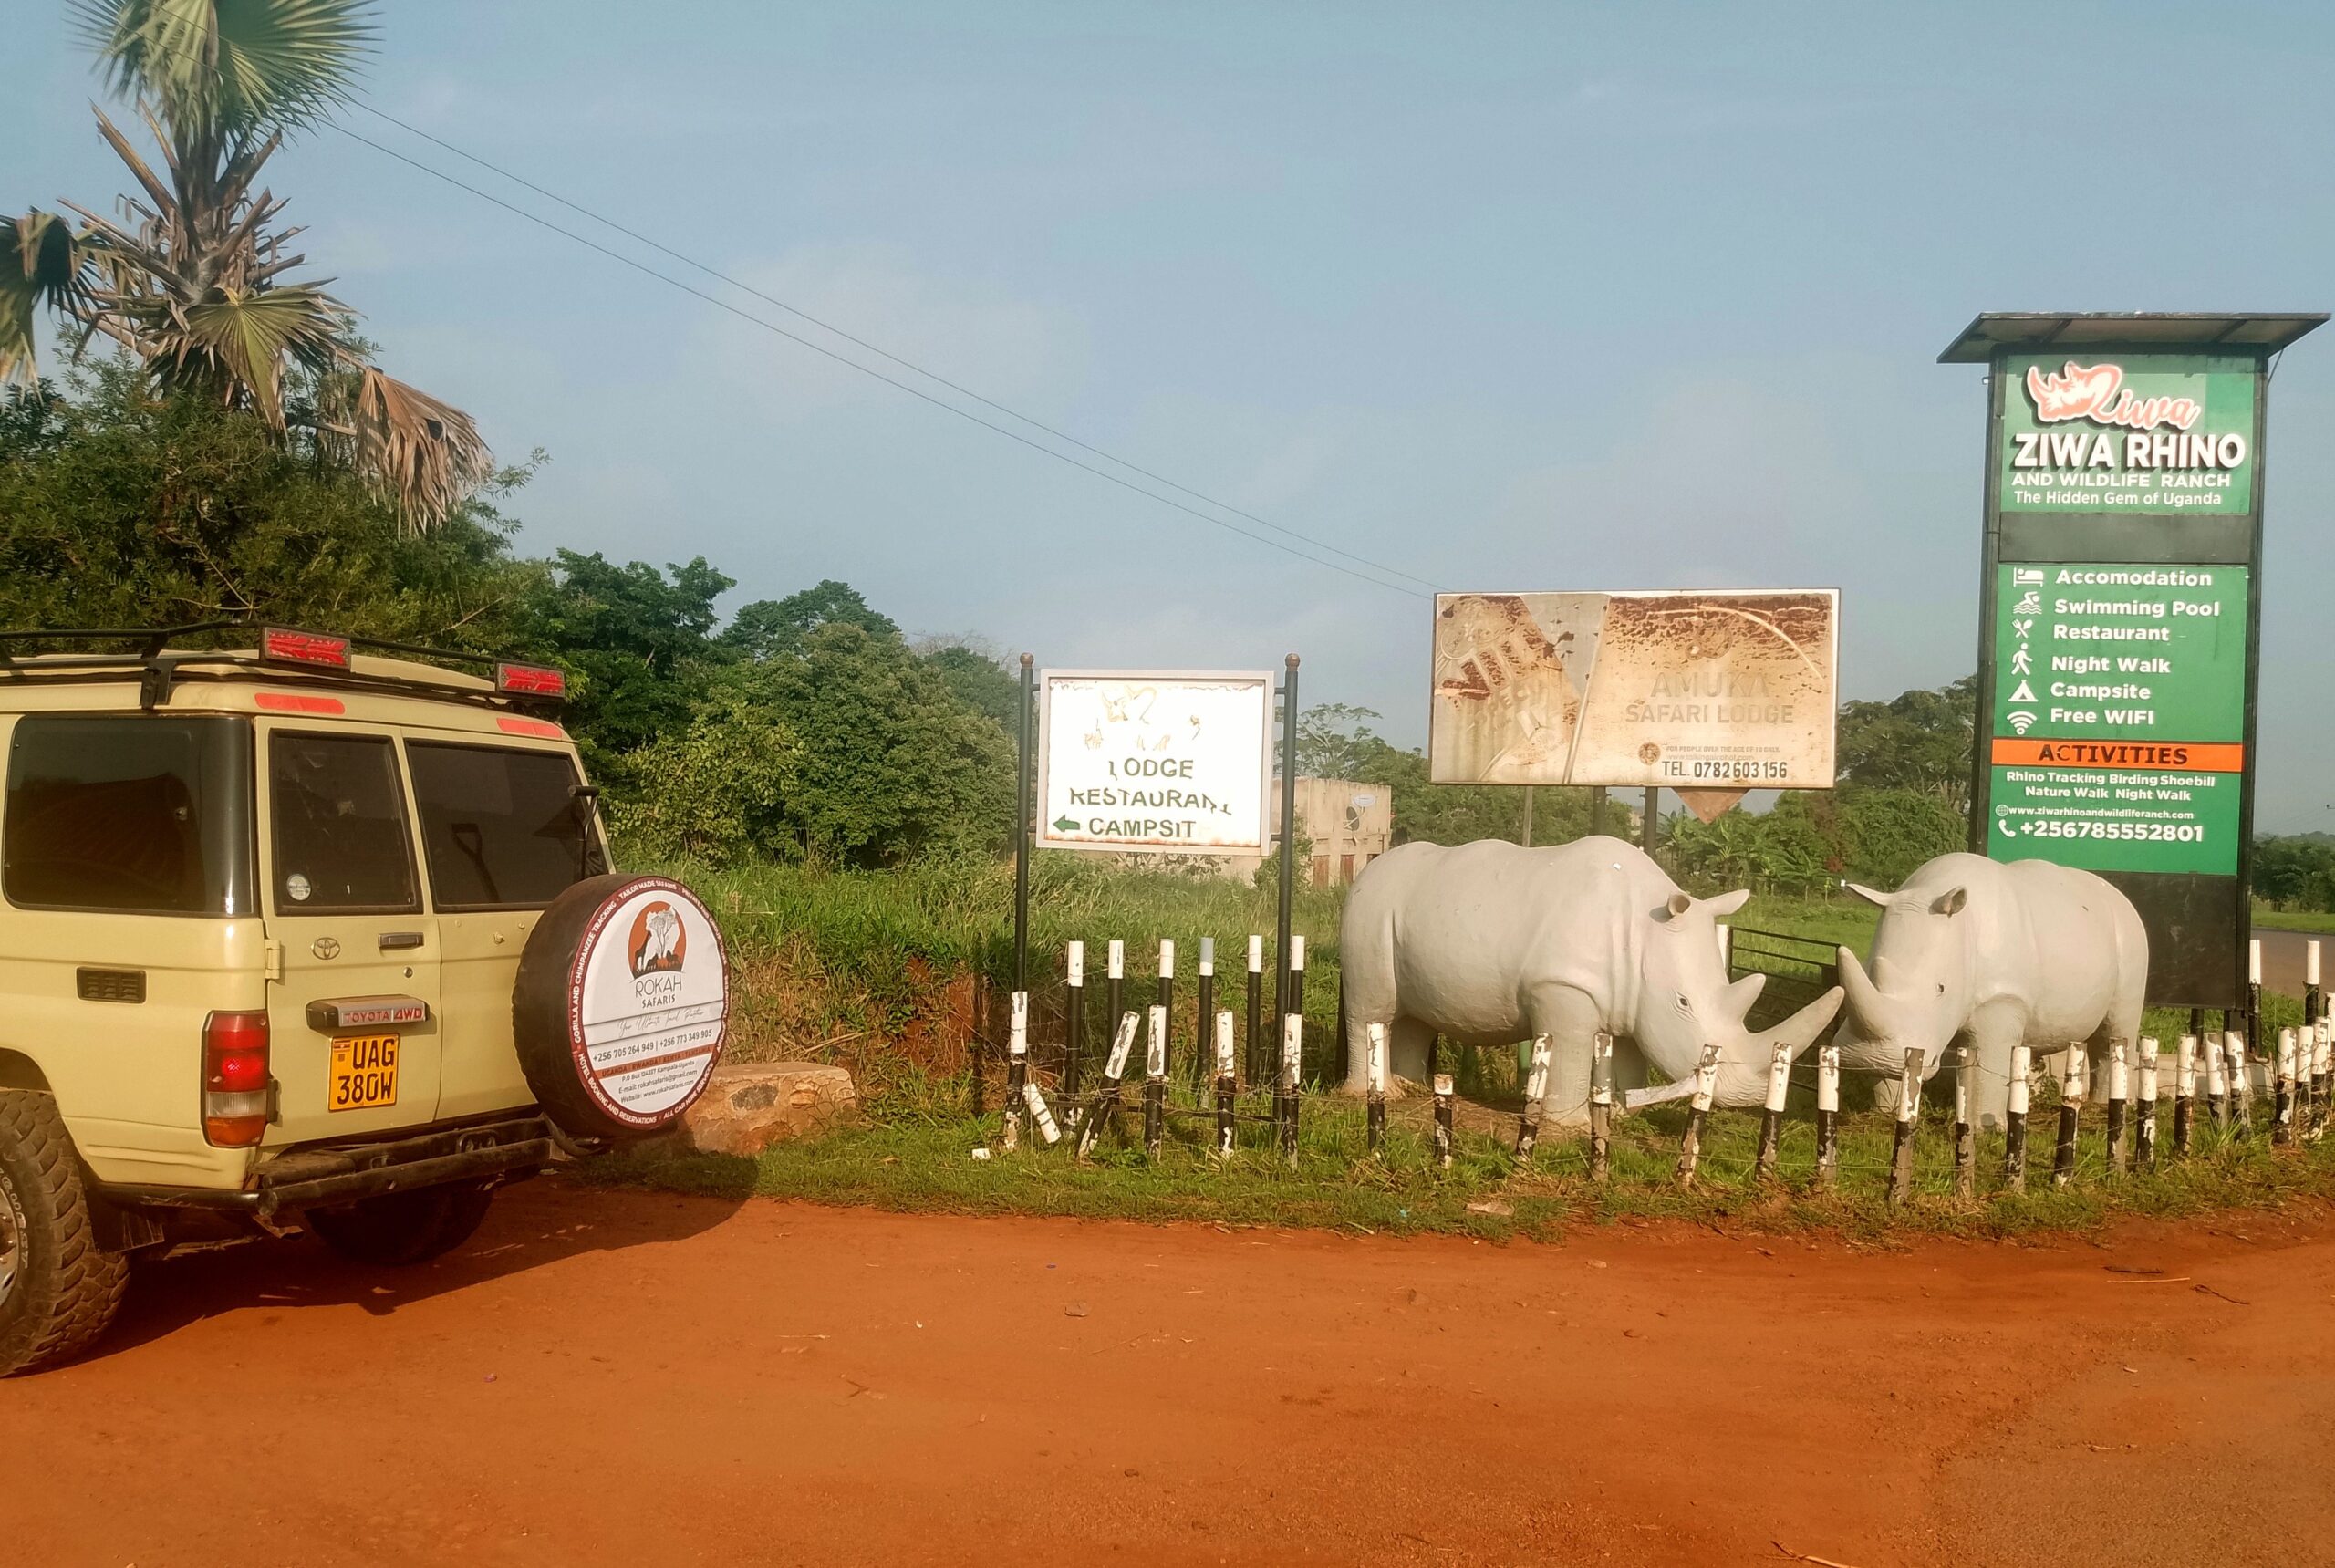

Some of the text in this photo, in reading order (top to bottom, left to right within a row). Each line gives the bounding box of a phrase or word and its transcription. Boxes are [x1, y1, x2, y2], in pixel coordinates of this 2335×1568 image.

[2014, 433, 2246, 468] ZIWA RHINO
[2011, 473, 2230, 487] AND WILDLIFE RANCH
[2014, 491, 2222, 507] The Hidden Gem of Uganda
[2055, 569, 2212, 587] Accomodation
[2054, 598, 2219, 618] Swimming Pool
[2053, 624, 2170, 641] Restaurant
[2051, 656, 2171, 674] Night Walk
[1651, 671, 1769, 698] AMUKA
[2050, 682, 2152, 701] Campsite
[1625, 704, 1794, 723] SAFARI LODGE
[2050, 708, 2153, 725] Free WIFI
[2038, 743, 2188, 765] ACTIVITIES
[1662, 761, 1690, 776] TEL.
[2007, 771, 2216, 787] Rhino Tracking Birding Shoebill
[2025, 786, 2191, 801] Nature Walk Night Walk
[2008, 806, 2194, 820] www.ziwarhinoandwildliferanch.com
[2020, 821, 2204, 842] +256785552801
[572, 901, 617, 1044] GORILLA AND CHIMPANZEE TRACKING
[636, 974, 682, 998] ROKAH
[642, 994, 675, 1008] SAFARIS
[345, 1008, 422, 1023] TOYOTA 4WD
[659, 1029, 712, 1047] +256 773 349 905
[353, 1038, 395, 1069] UAG
[594, 1042, 654, 1062] +256 705 264 949
[337, 1071, 393, 1105] 380W
[587, 1077, 608, 1106] BOOKING
[607, 1104, 619, 1116] AND
